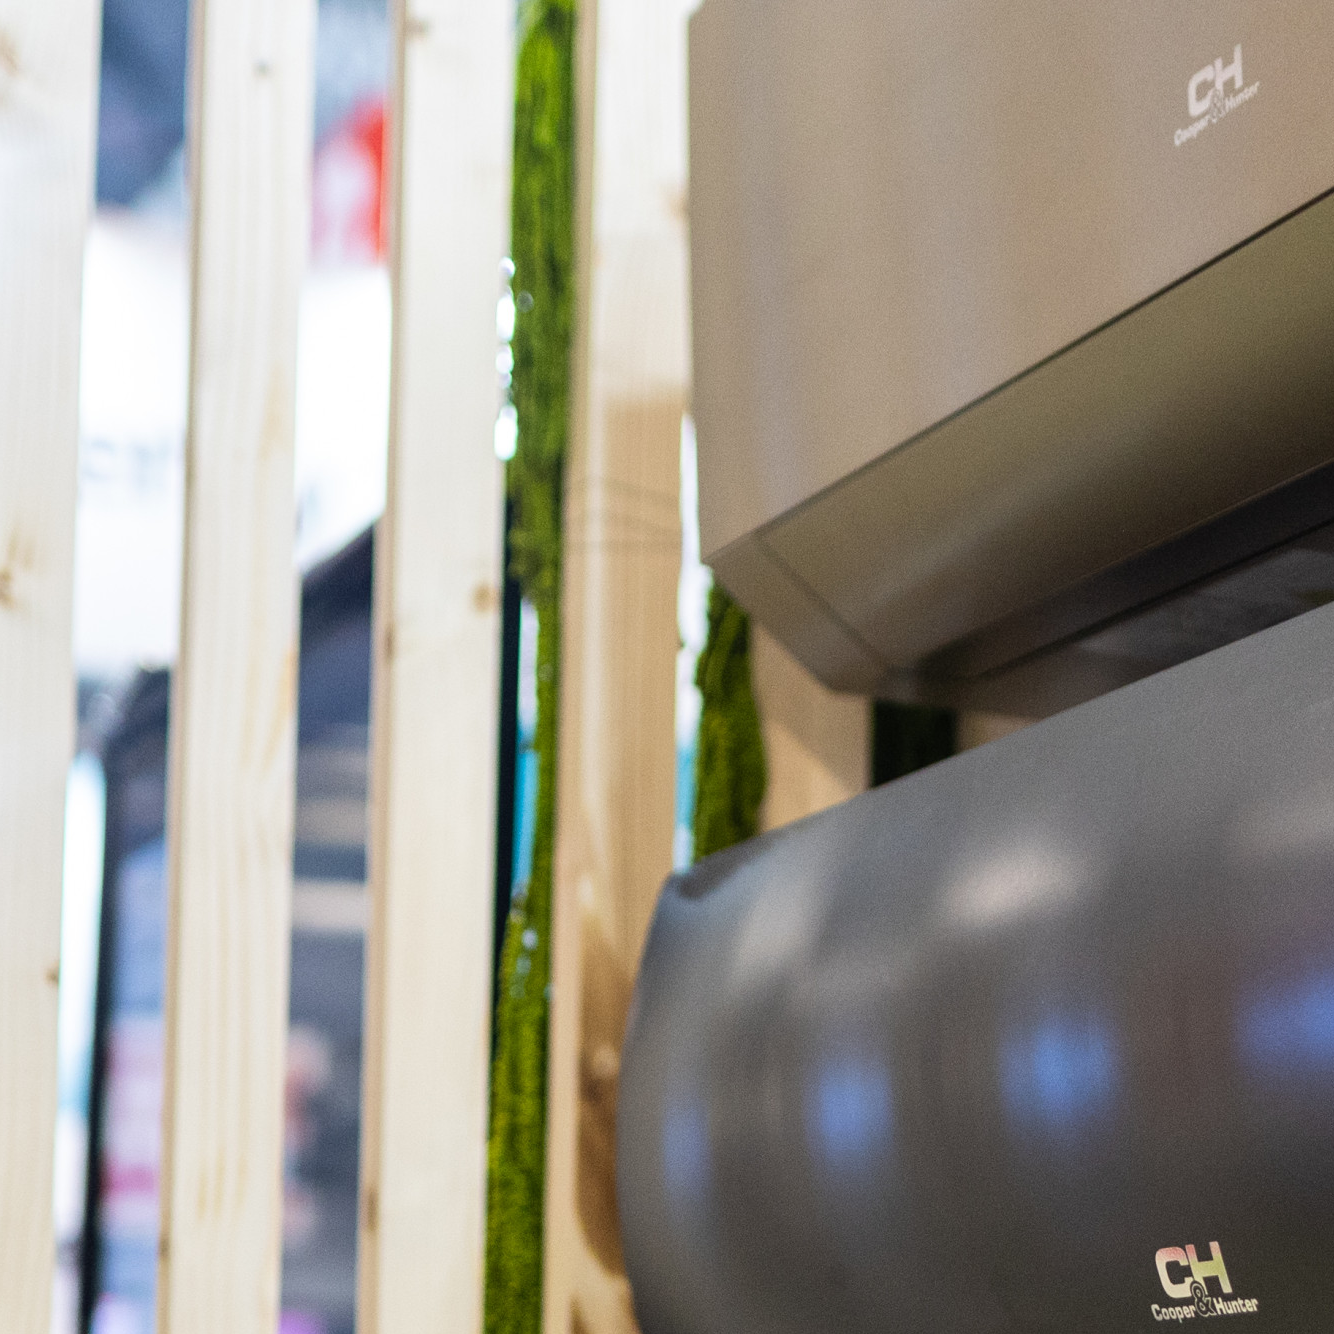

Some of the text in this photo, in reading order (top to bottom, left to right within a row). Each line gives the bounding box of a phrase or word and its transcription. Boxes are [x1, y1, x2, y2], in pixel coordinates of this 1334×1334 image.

[1188, 44, 1243, 117] CH
[1155, 1241, 1233, 1299] CH
[1151, 1304, 1196, 1323] Cooper
[1213, 1297, 1259, 1315] Hunter
